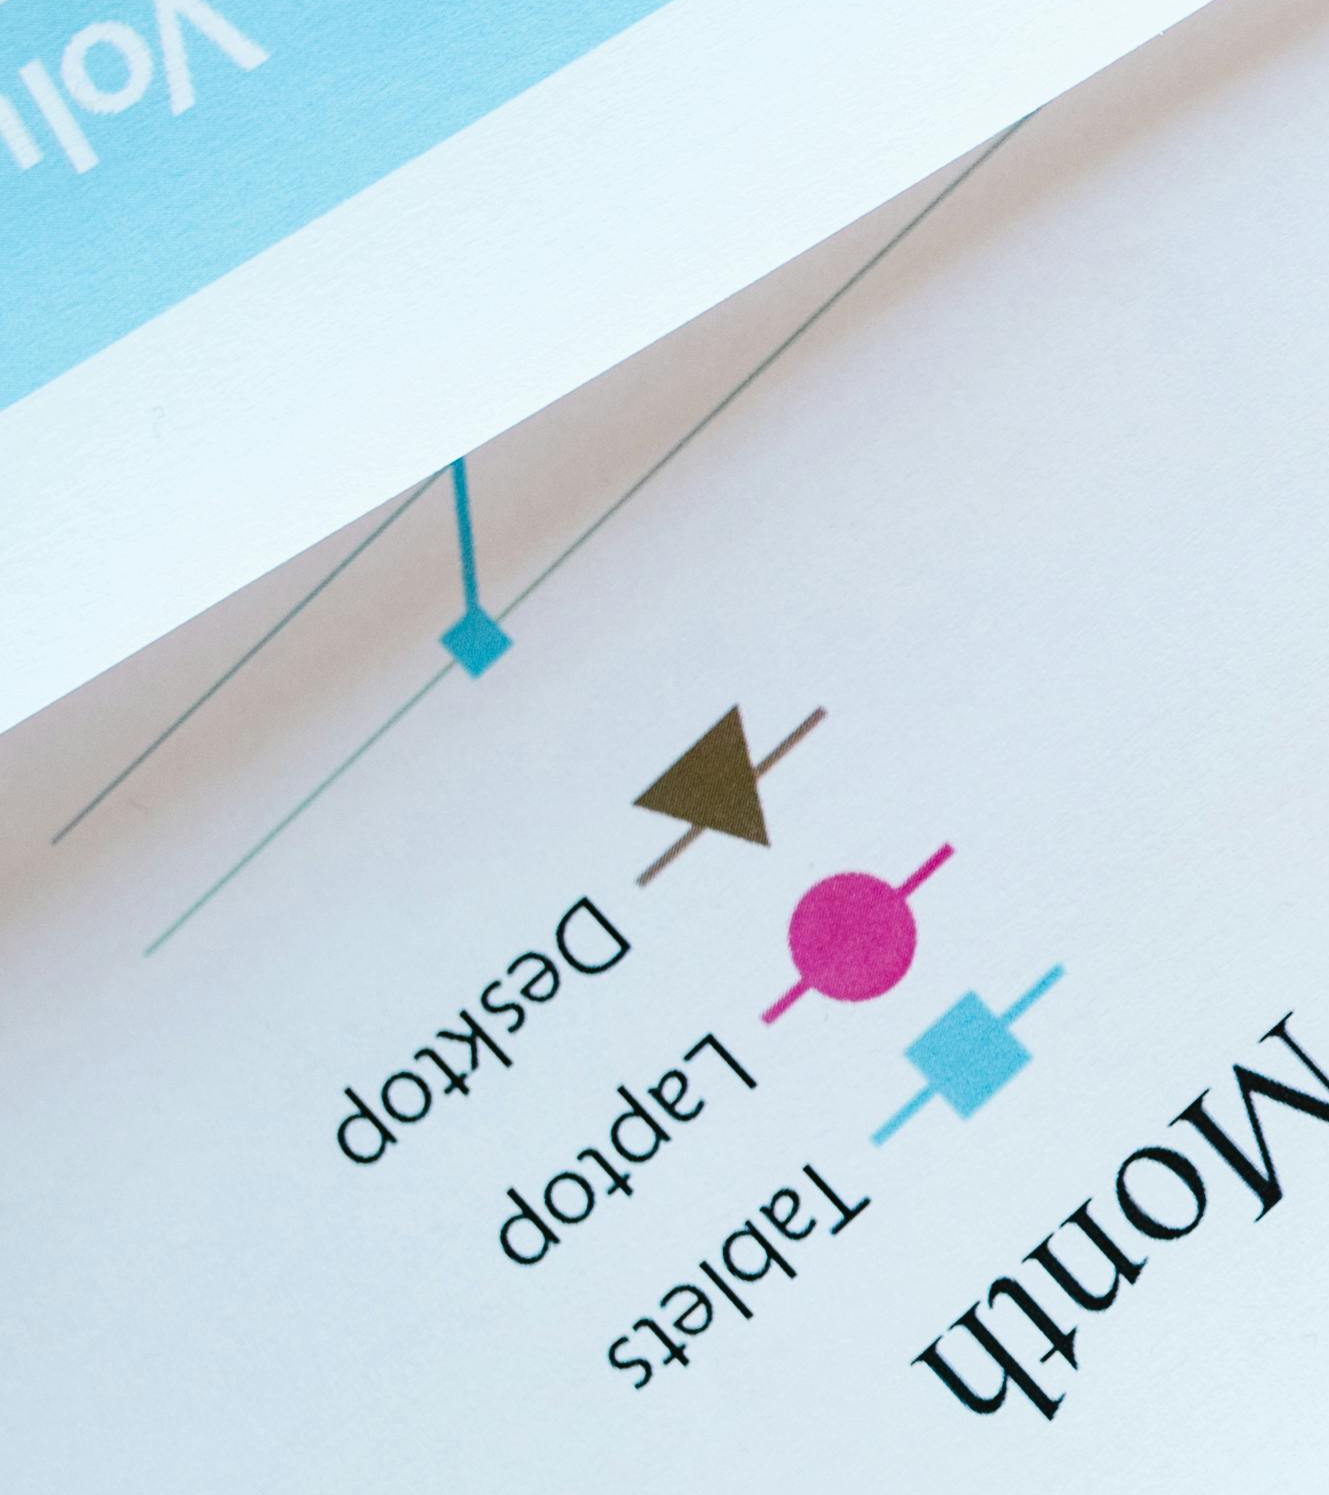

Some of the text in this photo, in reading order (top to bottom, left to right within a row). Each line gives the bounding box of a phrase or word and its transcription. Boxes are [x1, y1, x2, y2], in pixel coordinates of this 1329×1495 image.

[336, 896, 631, 1166] Desktop
[499, 1033, 758, 1266] Laptop
[607, 1163, 872, 1390] Tablets
